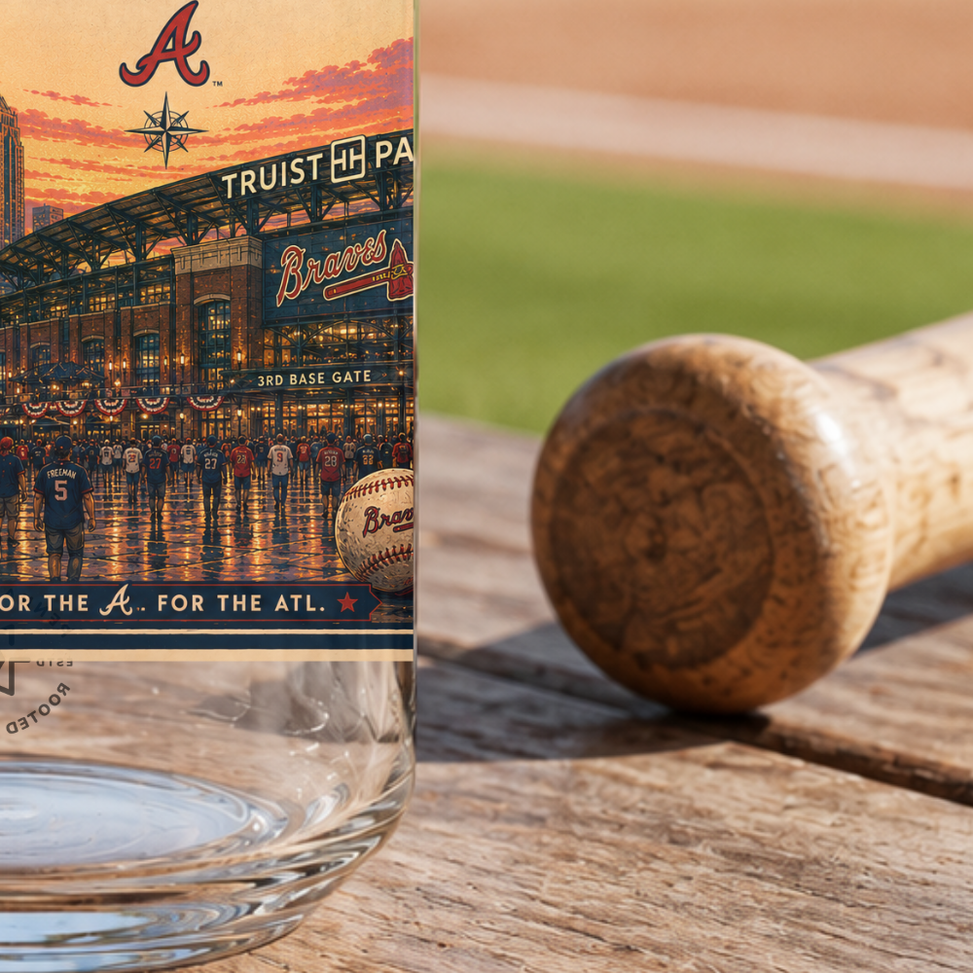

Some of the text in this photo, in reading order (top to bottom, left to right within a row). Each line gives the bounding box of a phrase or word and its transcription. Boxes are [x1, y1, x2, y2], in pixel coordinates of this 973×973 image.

[221, 152, 324, 199] TRUIST
[275, 228, 387, 308] Braves
[257, 369, 372, 387] 3RD BASE GATE
[54, 479, 68, 502] 5
[43, 594, 89, 612] THE
[157, 594, 205, 612] FOR
[217, 594, 263, 612] THE
[274, 594, 326, 612] ATL.
